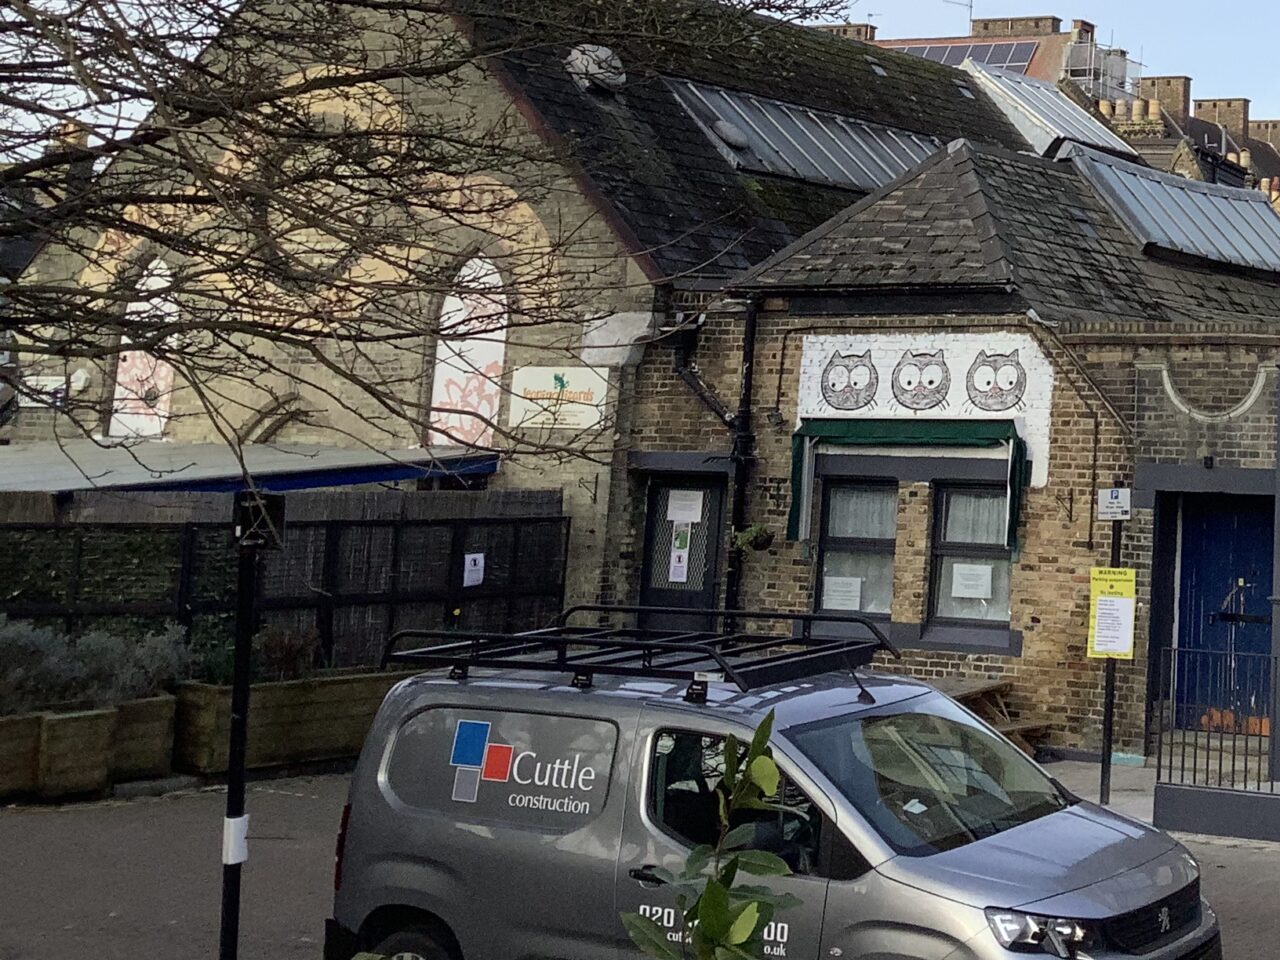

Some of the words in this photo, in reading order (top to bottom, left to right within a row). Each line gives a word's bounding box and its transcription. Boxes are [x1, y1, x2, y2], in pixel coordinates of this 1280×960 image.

[513, 751, 595, 791] Cuttle
[508, 793, 590, 814] construction
[763, 921, 789, 943] 00
[763, 943, 786, 957] o.uk
